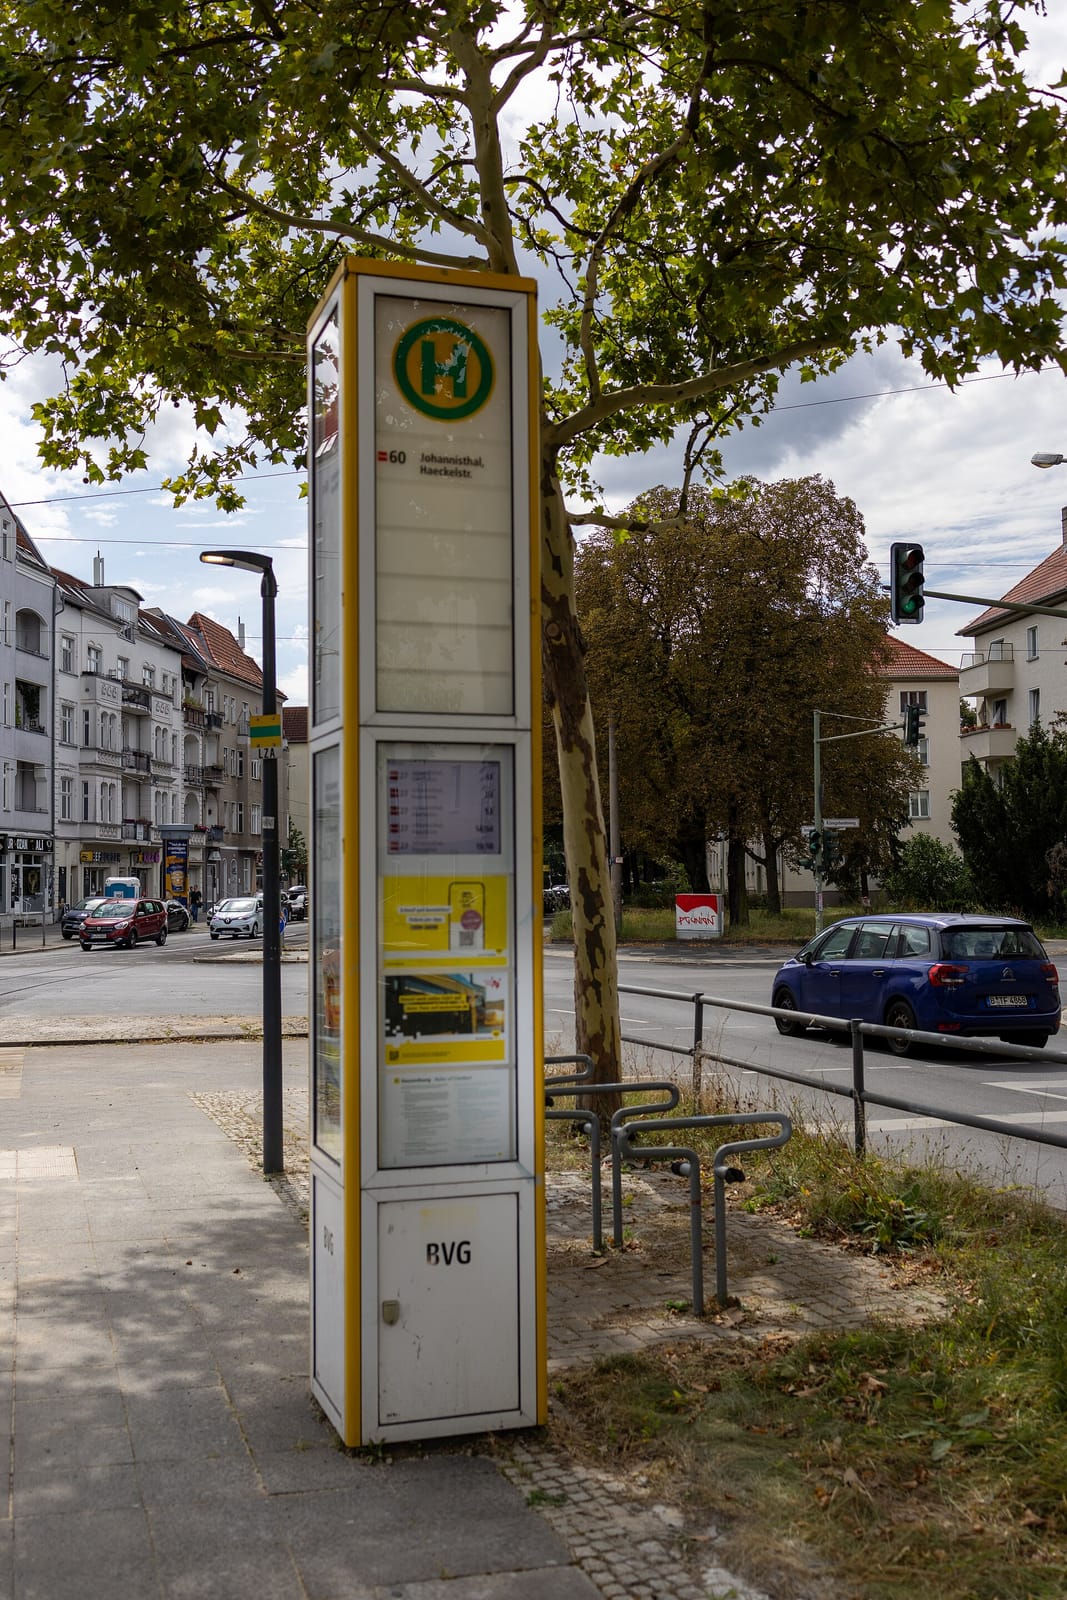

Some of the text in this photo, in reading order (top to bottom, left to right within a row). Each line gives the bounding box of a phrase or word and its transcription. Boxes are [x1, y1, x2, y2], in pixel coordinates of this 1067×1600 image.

[421, 341, 467, 398] H
[389, 450, 406, 464] 60
[420, 453, 485, 468] Johannisthal,
[420, 465, 473, 478] Haeckelstr.
[258, 748, 275, 759] LZA
[426, 1240, 471, 1266] BVG
